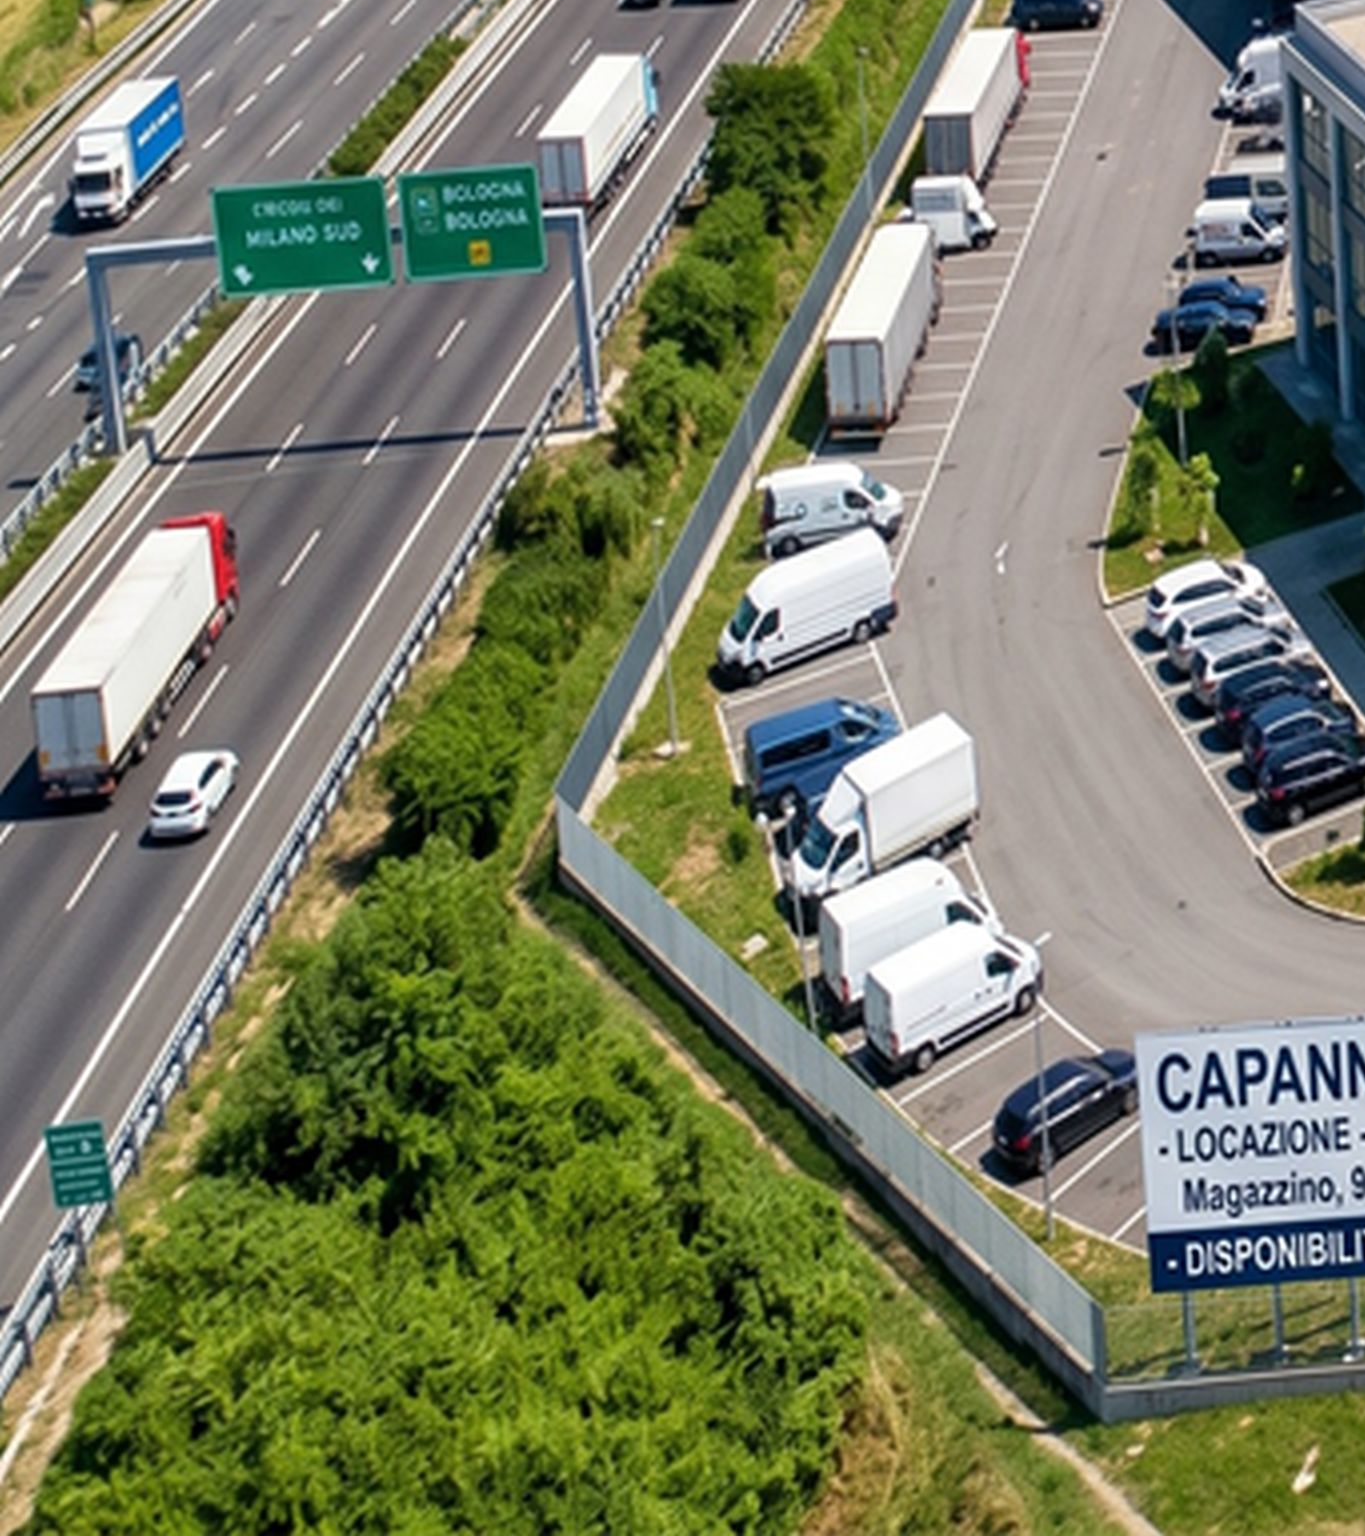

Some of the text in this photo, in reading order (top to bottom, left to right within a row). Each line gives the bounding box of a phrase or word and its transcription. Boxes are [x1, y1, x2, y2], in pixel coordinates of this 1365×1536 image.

[246, 223, 318, 248] MILANO
[1177, 1117, 1351, 1162] LOCAZIONE
[1184, 1171, 1344, 1218] Magazzino,
